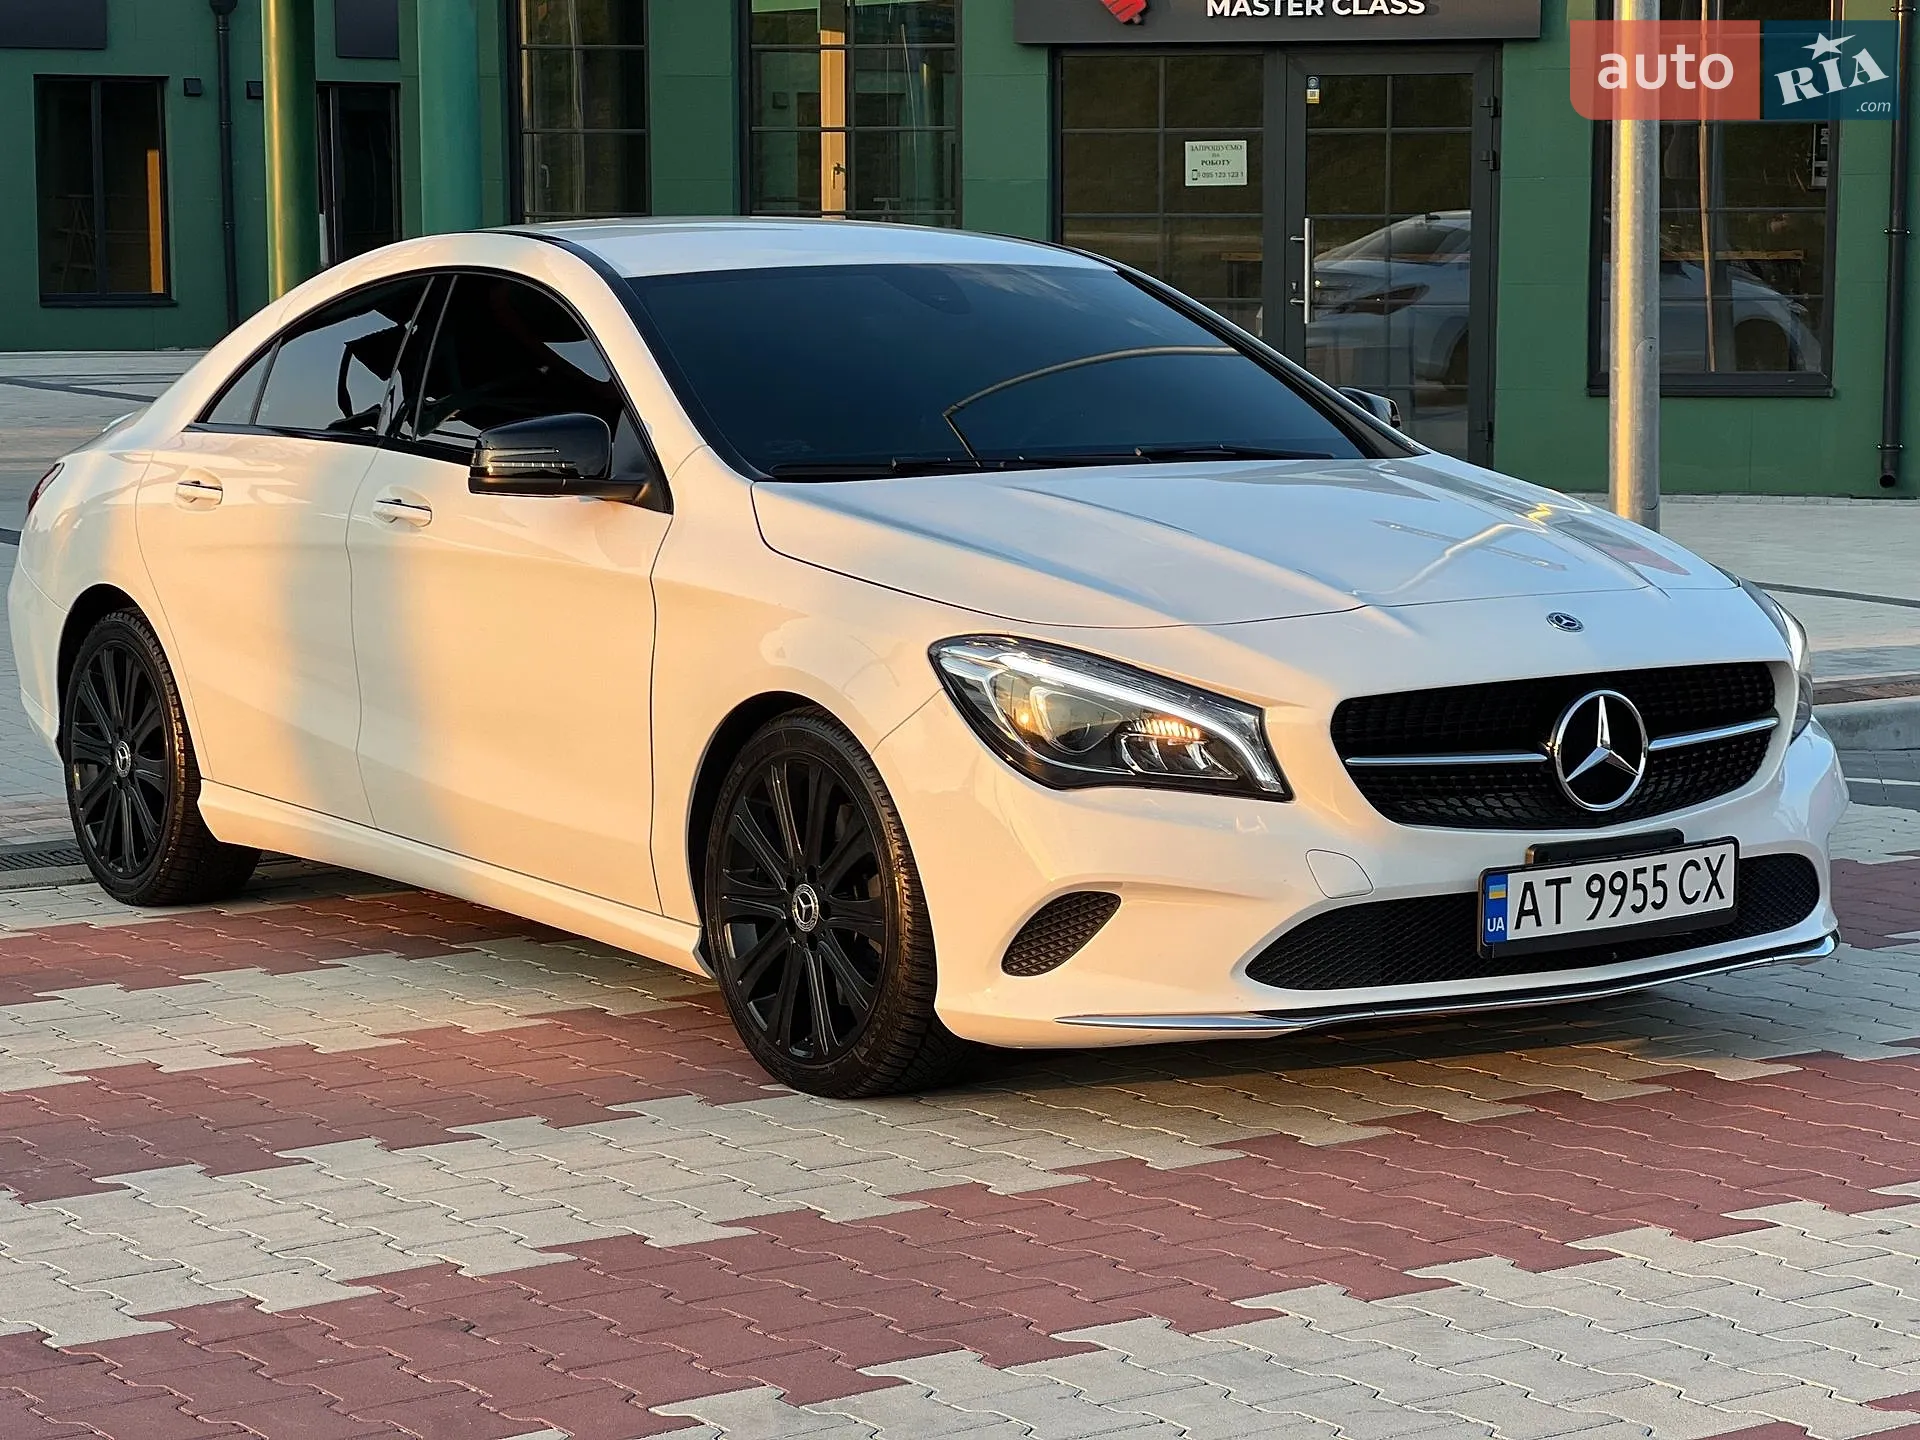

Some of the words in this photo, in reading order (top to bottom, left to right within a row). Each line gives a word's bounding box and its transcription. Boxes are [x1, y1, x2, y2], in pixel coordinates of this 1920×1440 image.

[1206, 0, 1324, 17] MASTER
[1332, 0, 1426, 16] CLASS
[1514, 876, 1572, 930] AT
[1585, 863, 1668, 921] 9955
[1678, 853, 1727, 905] CX
[1487, 917, 1505, 932] UA
